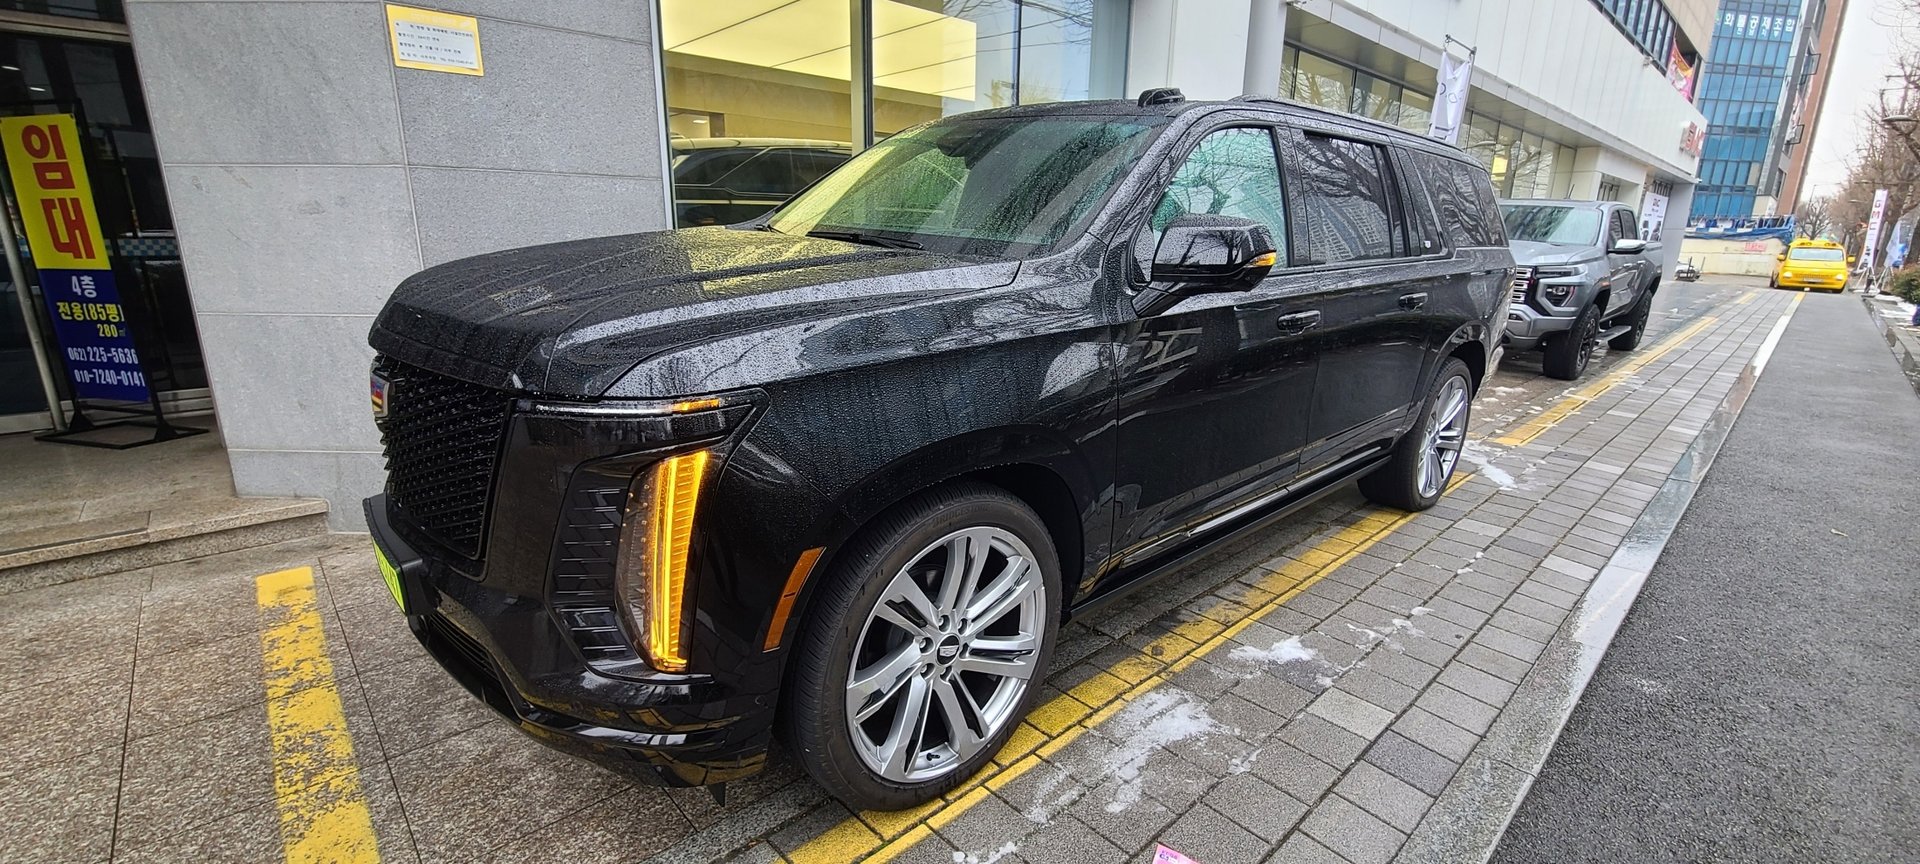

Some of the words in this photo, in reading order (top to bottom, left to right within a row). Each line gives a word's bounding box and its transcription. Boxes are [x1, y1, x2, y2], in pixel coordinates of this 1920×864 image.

[21, 124, 96, 260] 임대
[71, 275, 97, 298] 4층
[56, 302, 125, 322] 전용(85평)
[74, 368, 146, 388] 010-7240-0141
